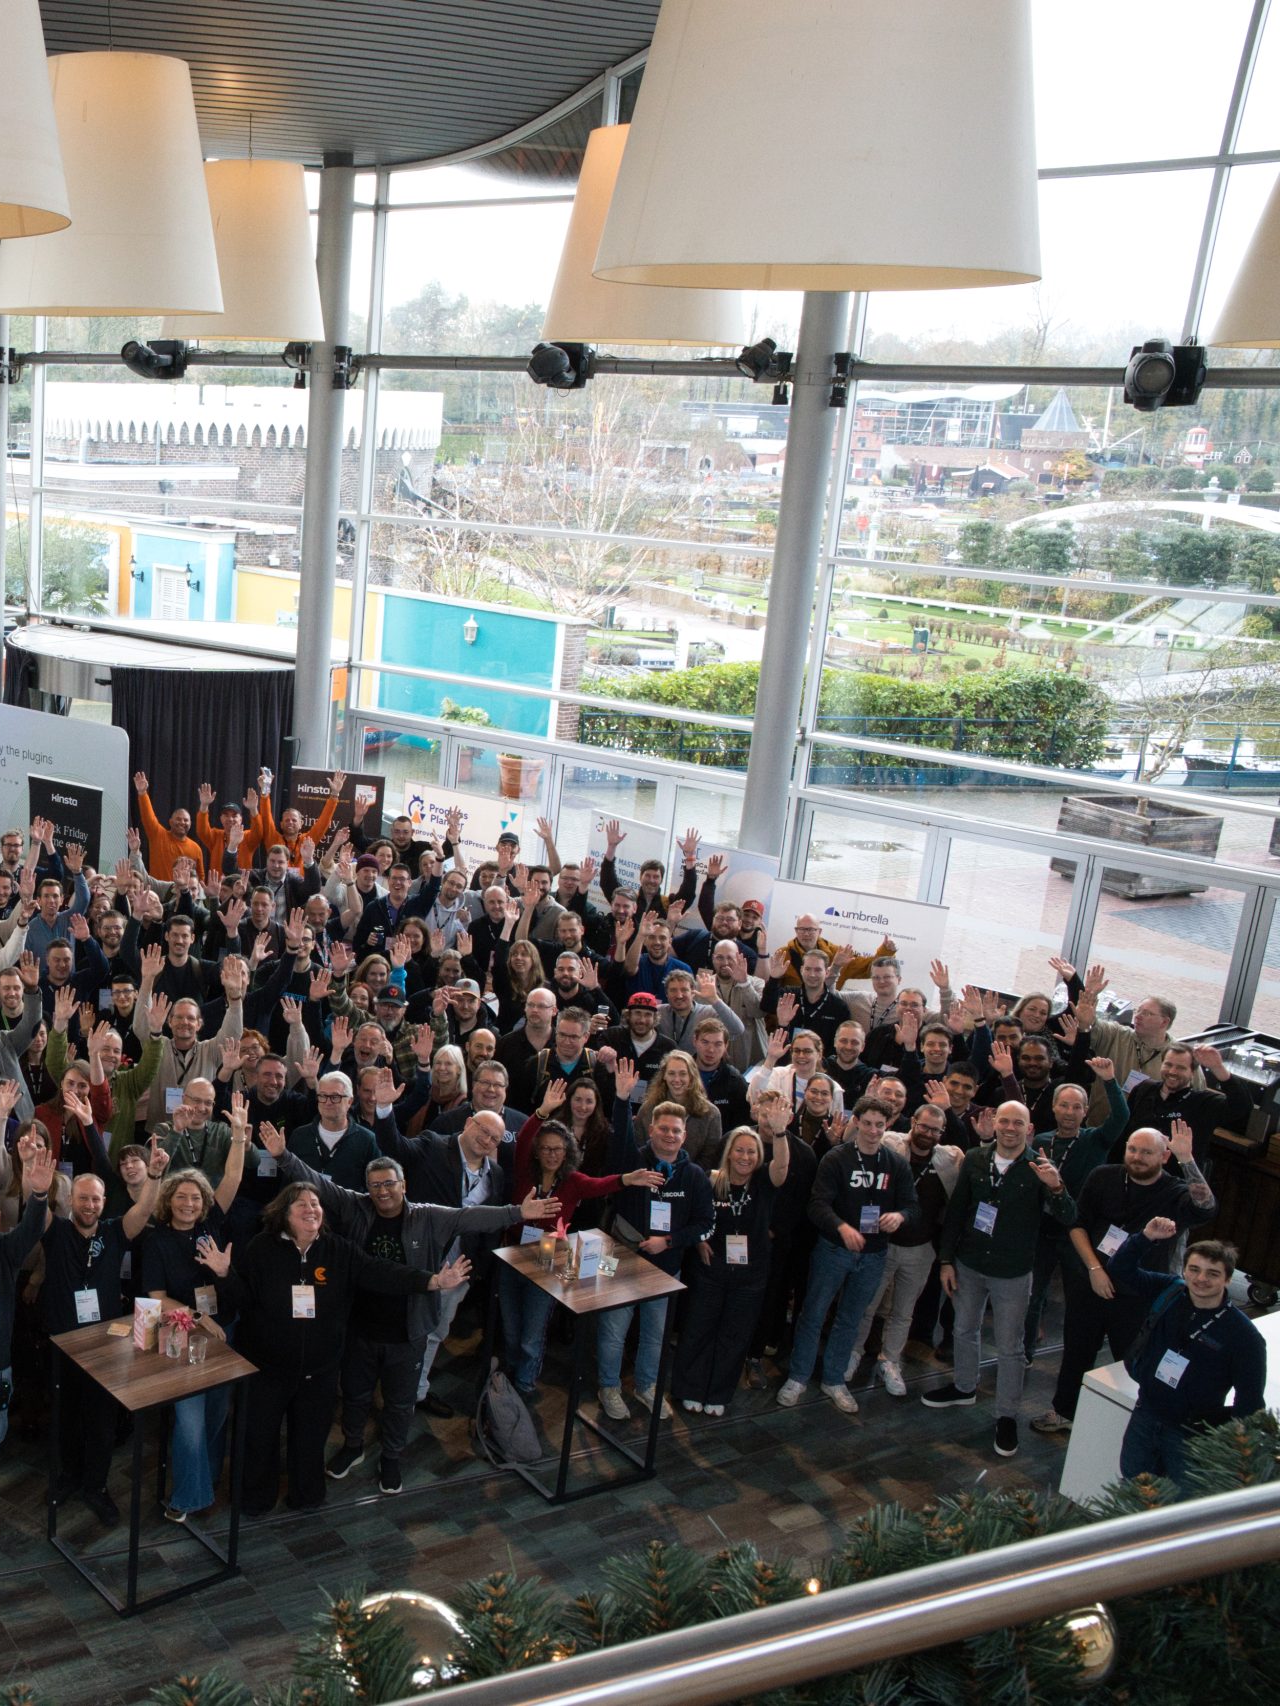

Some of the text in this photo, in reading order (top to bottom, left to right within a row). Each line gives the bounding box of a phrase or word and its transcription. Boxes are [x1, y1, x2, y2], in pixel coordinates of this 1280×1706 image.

[6, 744, 20, 757] the
[22, 750, 53, 765] plugins
[64, 825, 88, 842] Friday
[460, 840, 486, 850] rdPress
[841, 910, 889, 926] umbrella
[849, 1170, 884, 1190] 501
